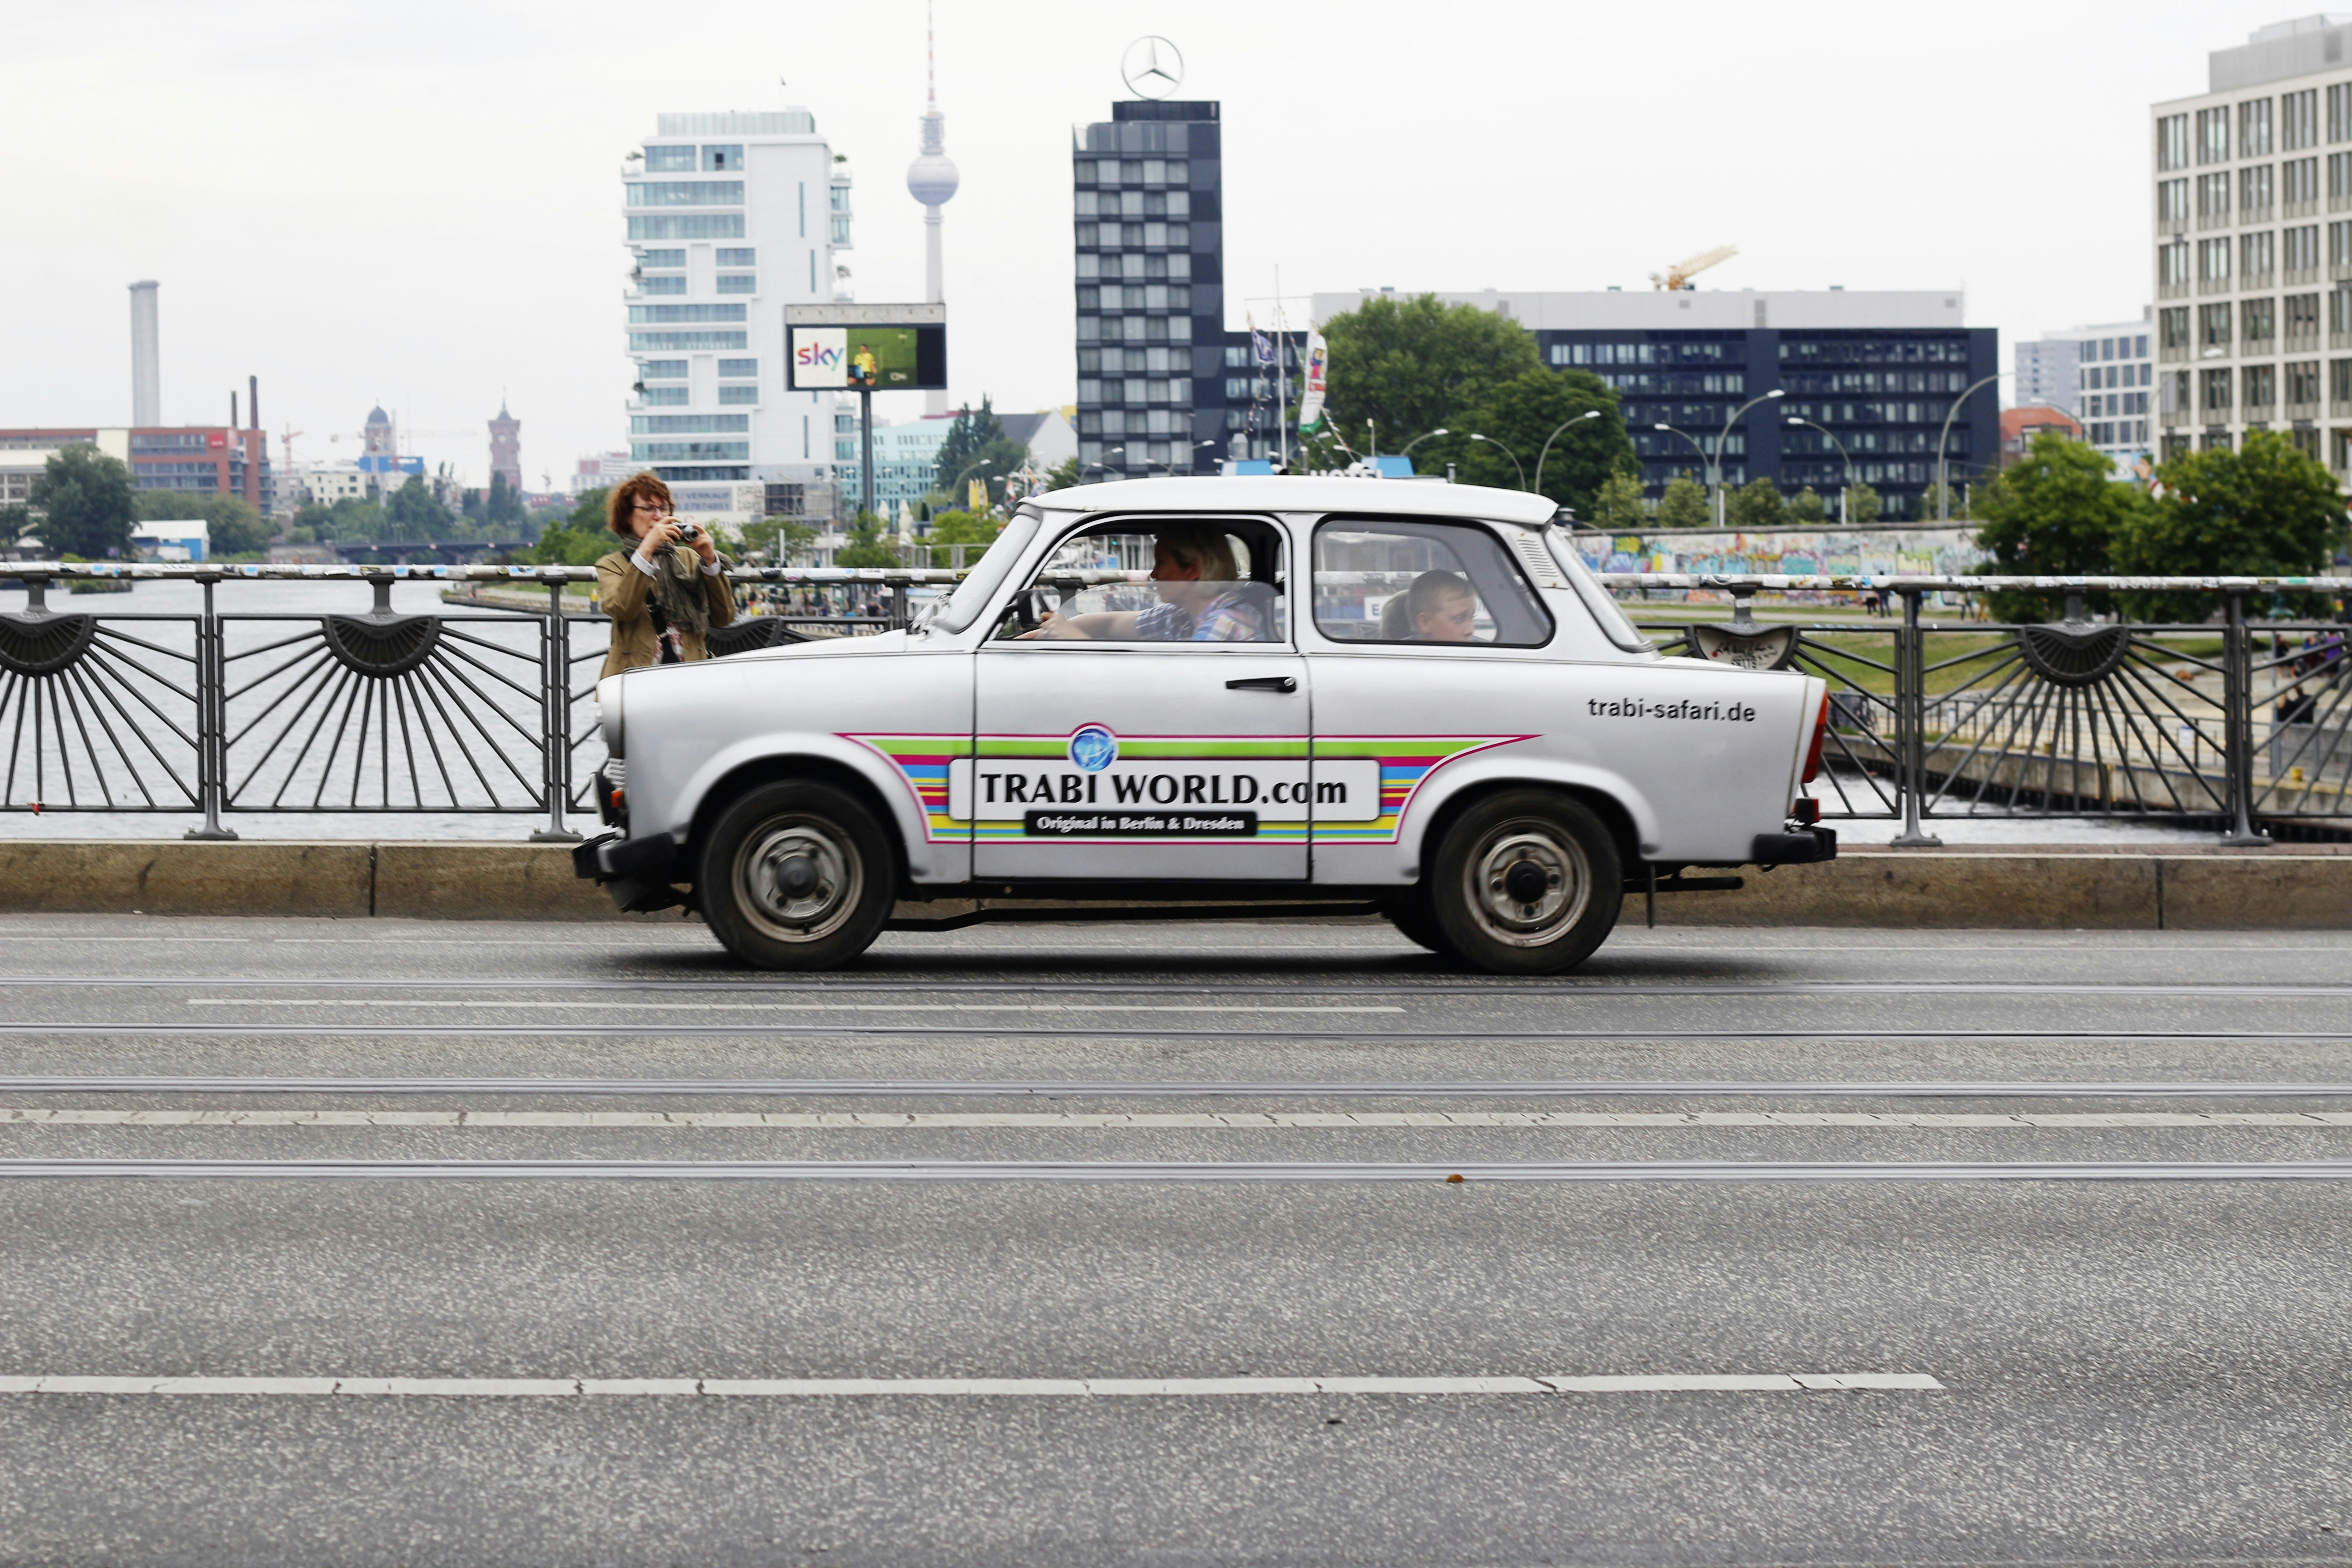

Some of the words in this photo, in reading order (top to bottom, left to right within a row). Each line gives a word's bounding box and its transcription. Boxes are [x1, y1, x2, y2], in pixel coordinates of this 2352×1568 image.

[798, 342, 843, 371] sky
[1588, 698, 1756, 722] trabi-safari.de
[980, 773, 1097, 803] TRABI
[1111, 774, 1347, 804] WORLD.com
[1037, 816, 1098, 833] Original
[1101, 816, 1116, 829] in
[1119, 816, 1164, 829] Berlin
[1167, 817, 1181, 829] &
[1183, 817, 1244, 829] Dresden
